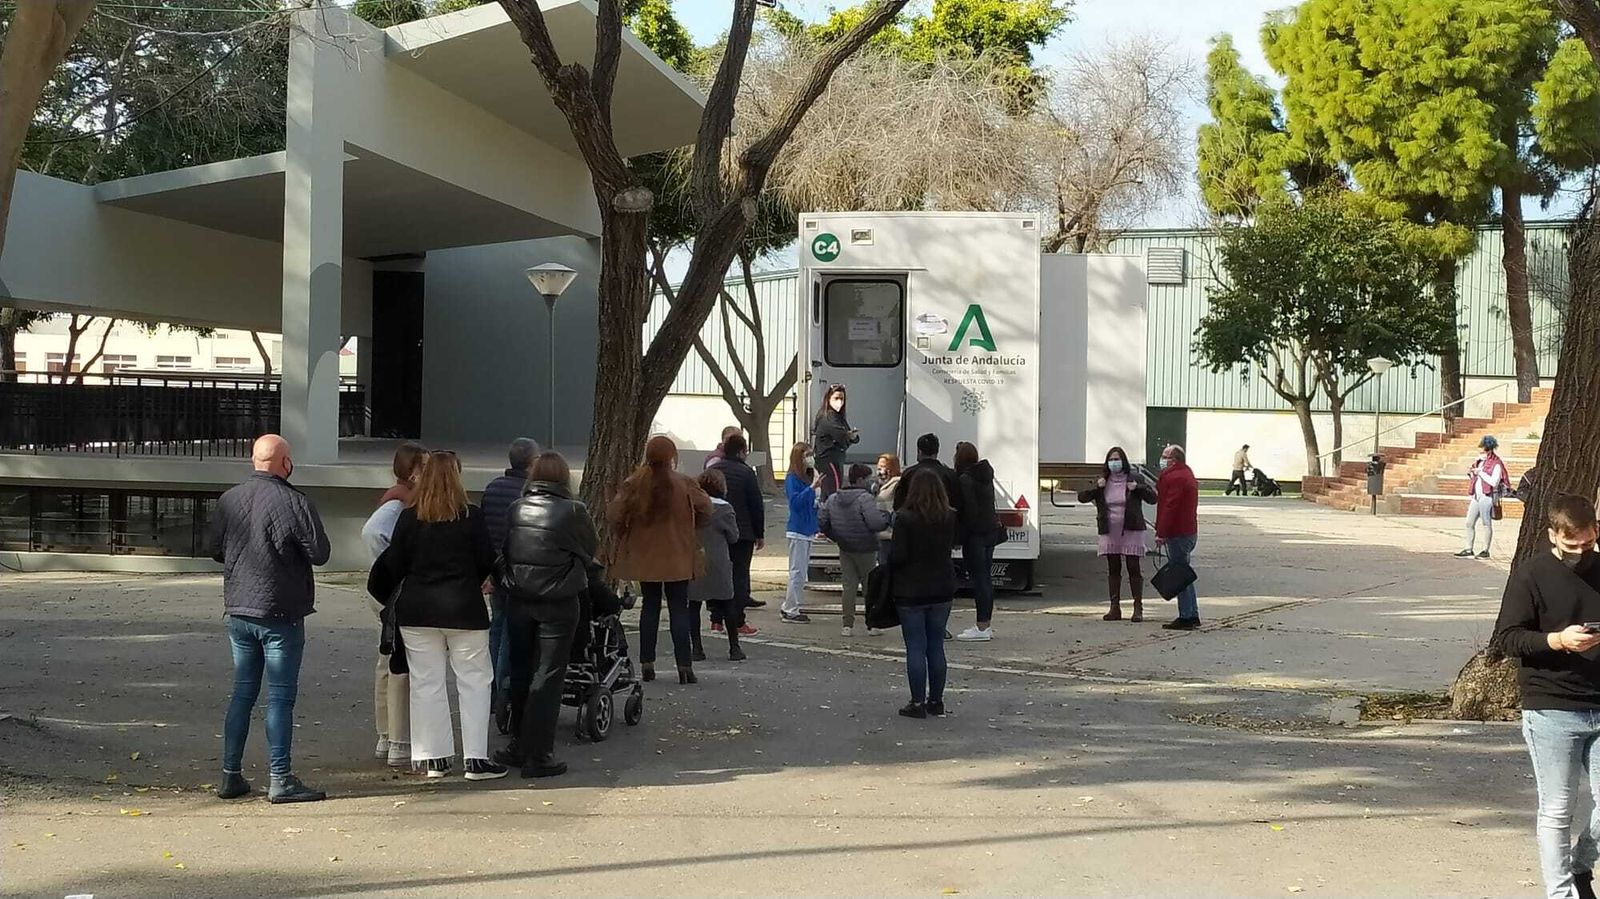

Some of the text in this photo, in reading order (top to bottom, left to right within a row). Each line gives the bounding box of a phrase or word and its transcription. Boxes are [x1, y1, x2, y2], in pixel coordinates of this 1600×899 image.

[814, 241, 839, 255] C4
[922, 354, 1026, 366] Junta de Andalucía
[1009, 531, 1026, 541] HYP
